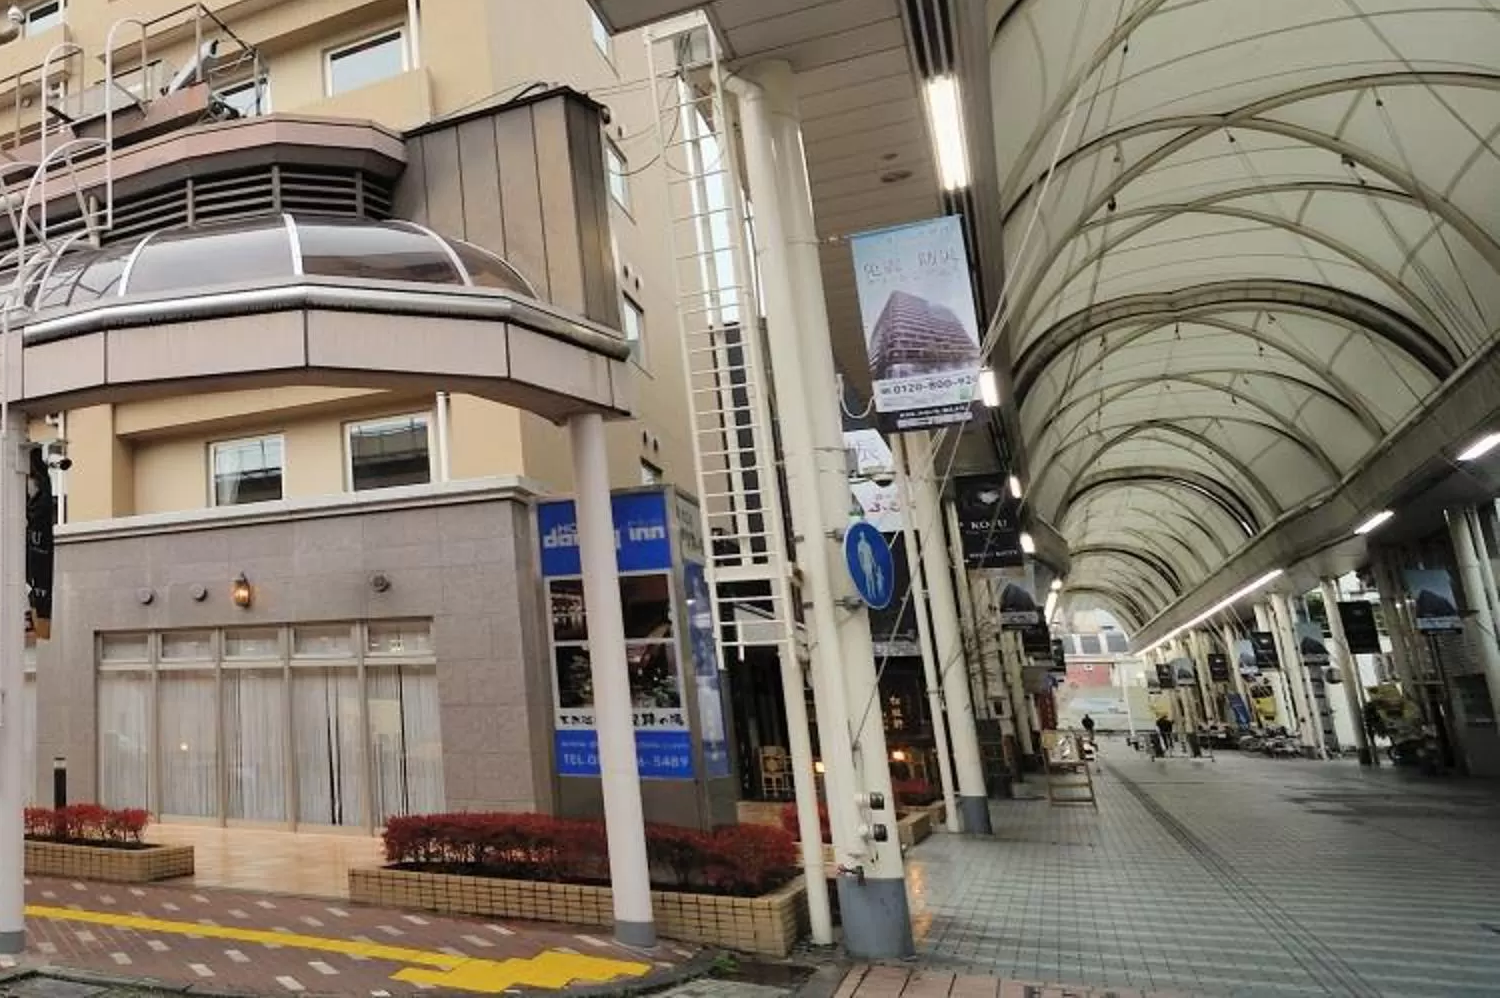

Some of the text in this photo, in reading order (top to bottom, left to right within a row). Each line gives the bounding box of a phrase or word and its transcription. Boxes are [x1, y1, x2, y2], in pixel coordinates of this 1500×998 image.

[893, 375, 976, 394] 0120-800-92
[543, 527, 621, 549] doy
[629, 525, 666, 541] inn
